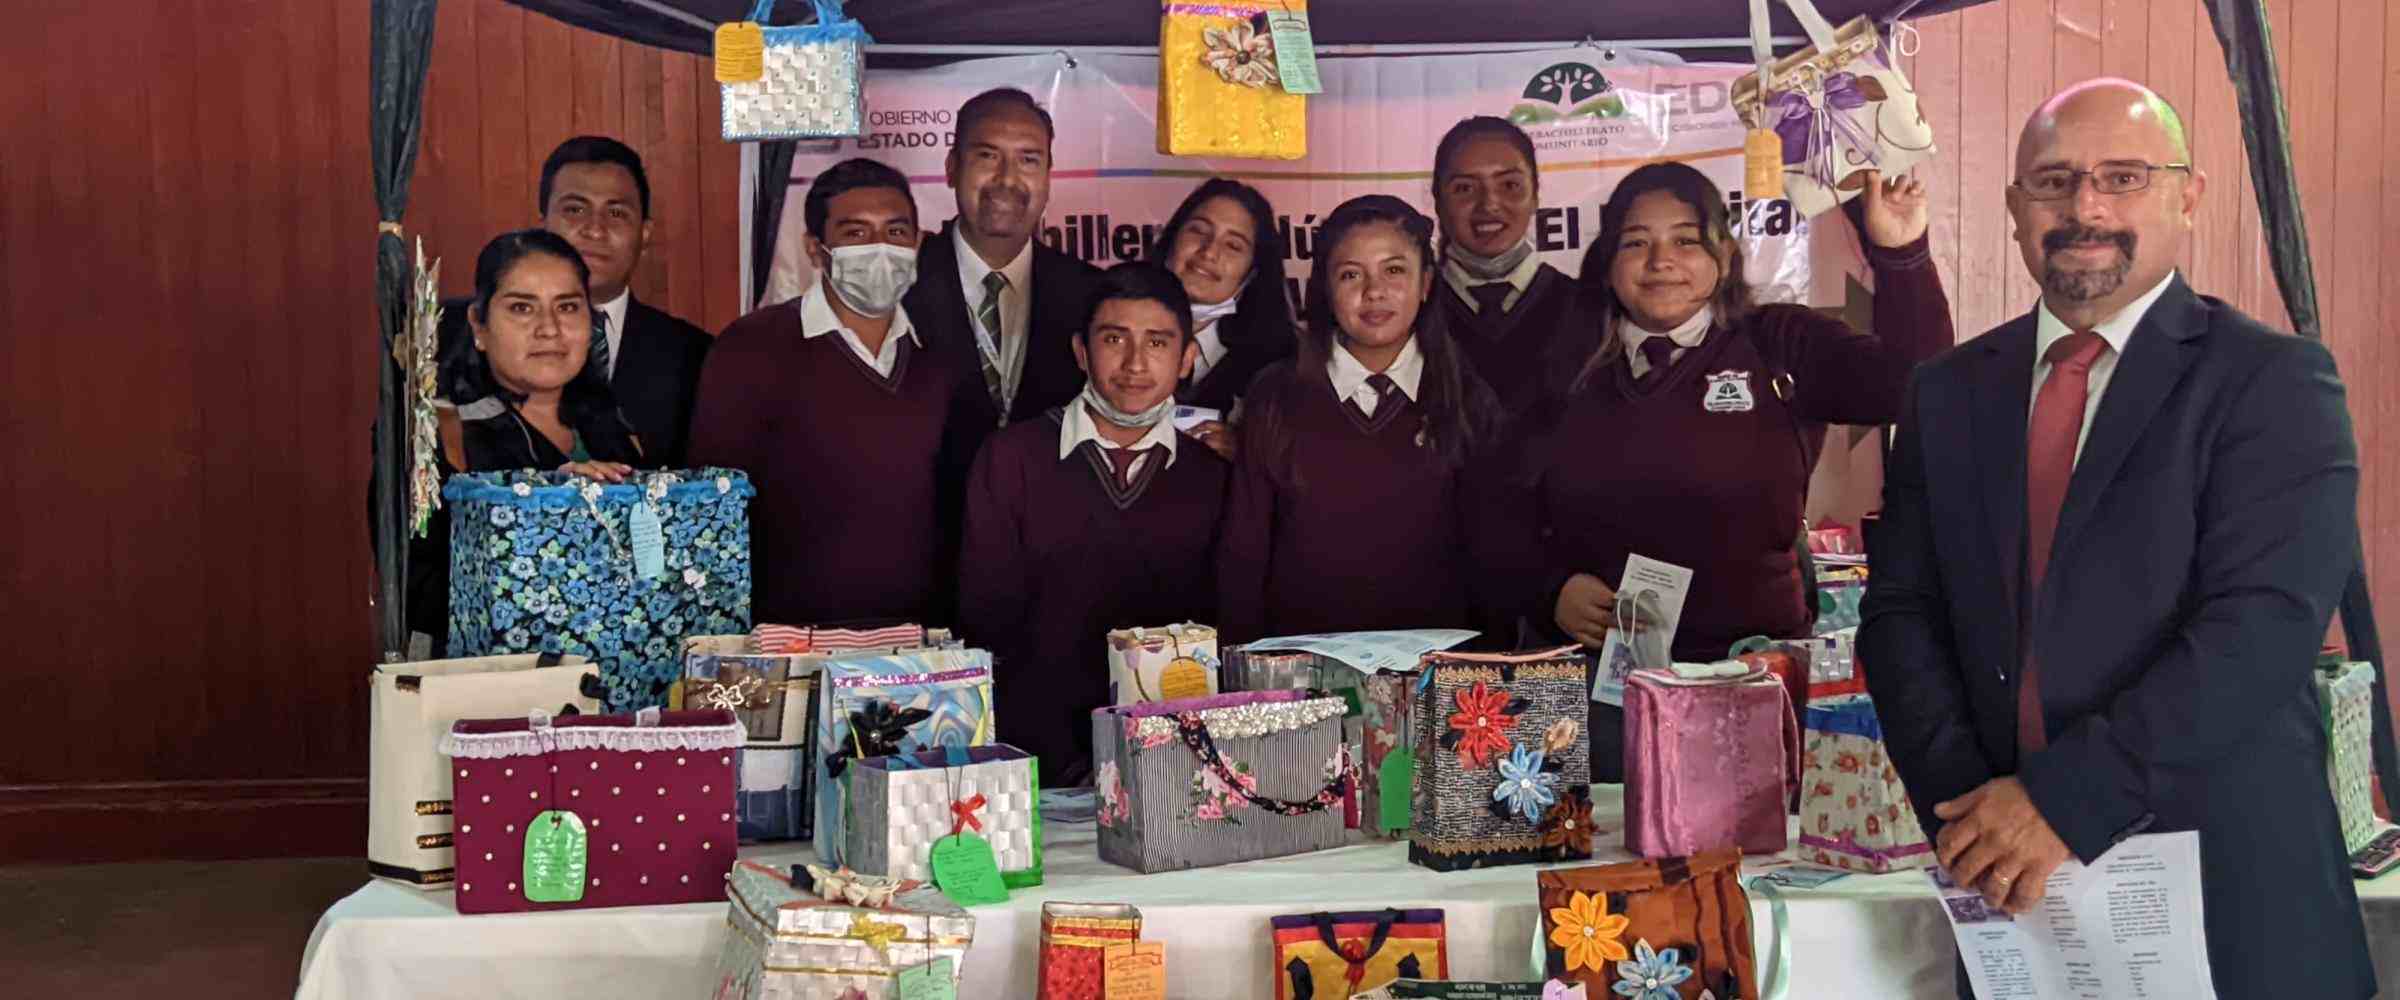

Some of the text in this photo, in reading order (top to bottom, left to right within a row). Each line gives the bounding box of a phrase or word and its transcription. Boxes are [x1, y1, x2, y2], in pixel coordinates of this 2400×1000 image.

[869, 110, 952, 126] OBIERNO
[857, 132, 938, 149] ESTADO
[1536, 207, 1580, 251] El
